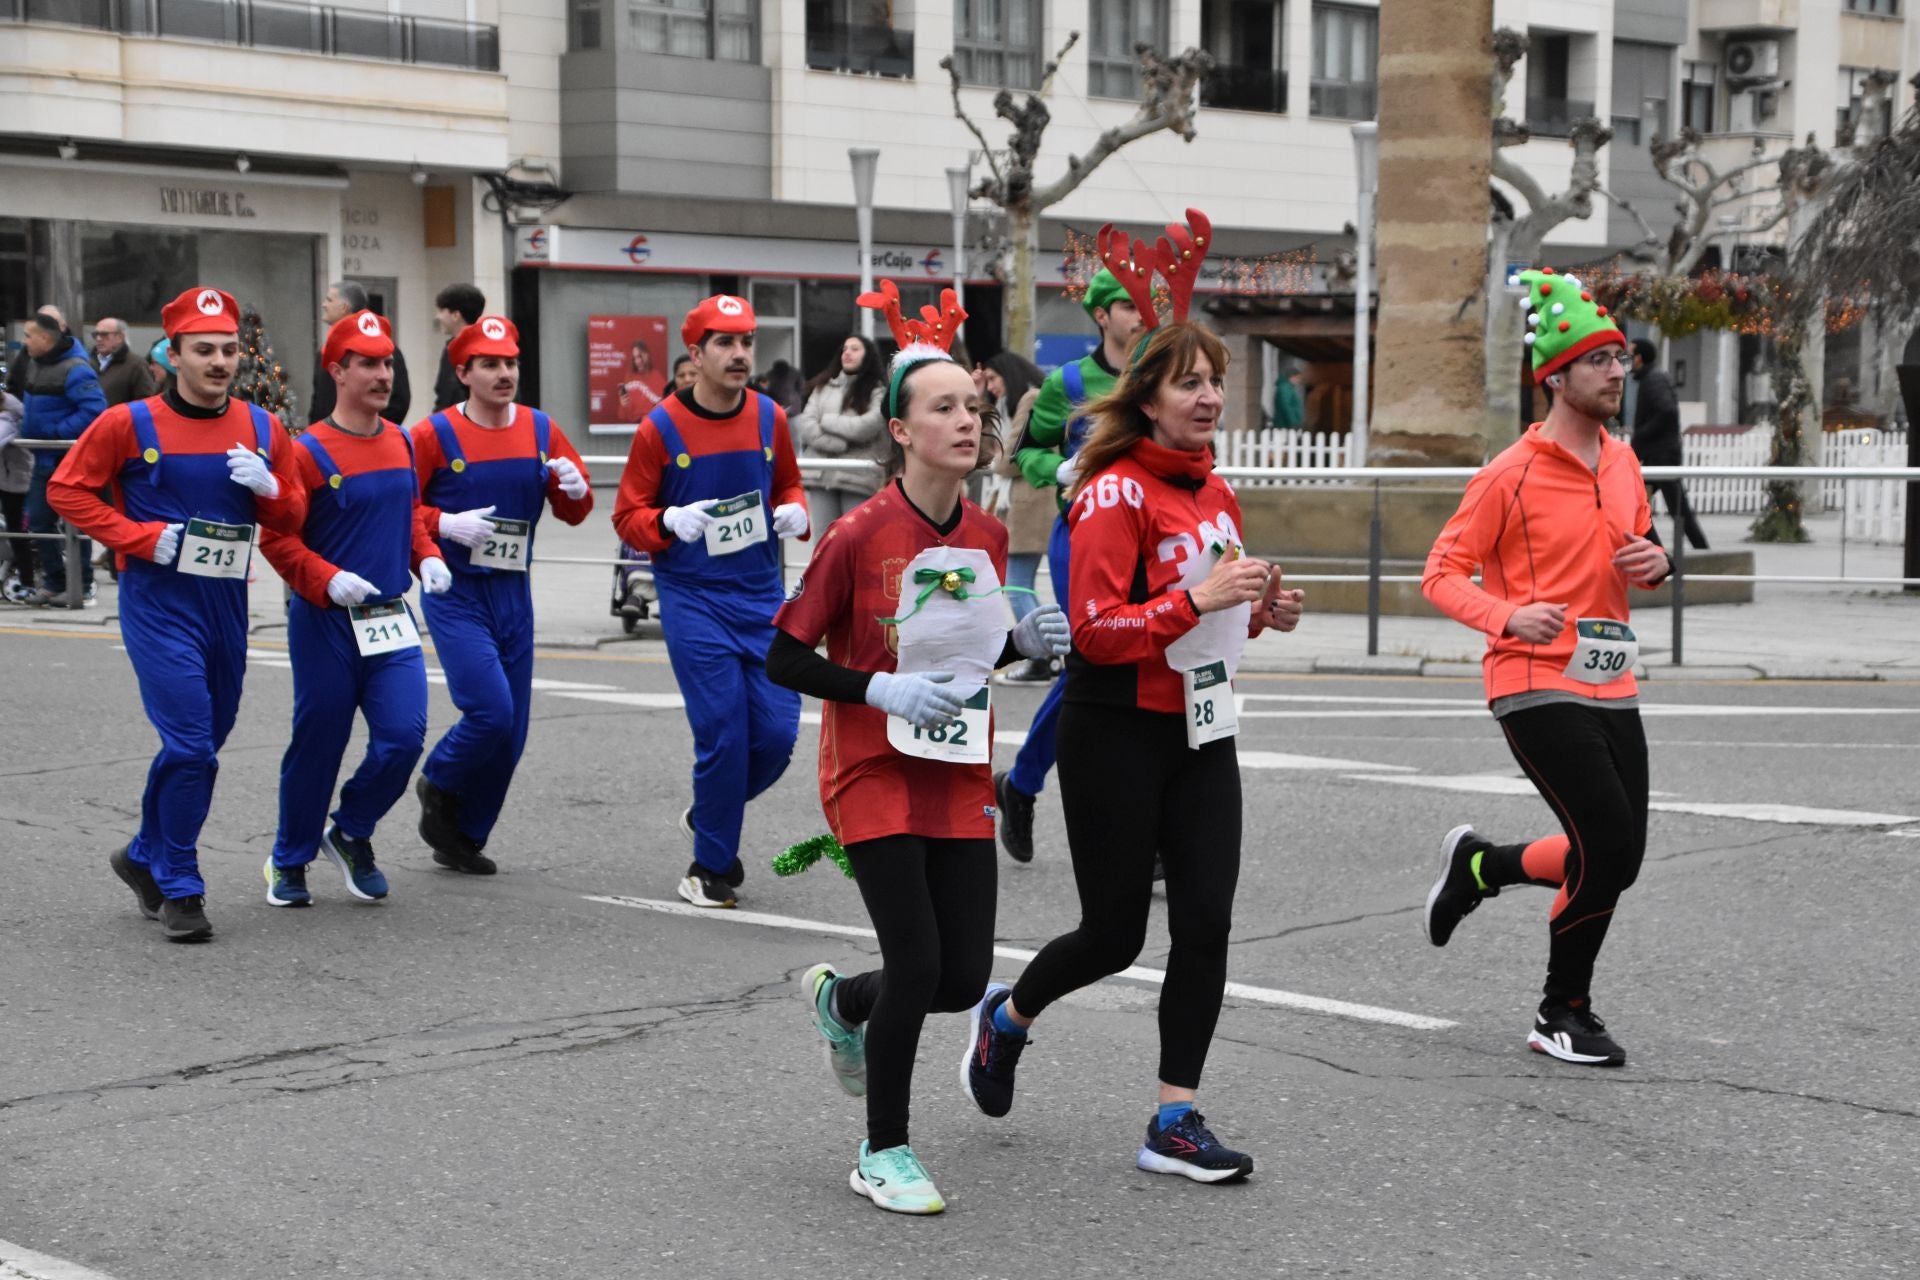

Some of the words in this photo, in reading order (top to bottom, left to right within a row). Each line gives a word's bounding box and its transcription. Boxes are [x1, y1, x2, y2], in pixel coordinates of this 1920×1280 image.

[200, 294, 219, 308] M
[362, 317, 377, 330] M
[1077, 474, 1144, 521] 360
[718, 517, 753, 542] 210
[194, 546, 235, 566] 213
[483, 540, 519, 559] 212
[366, 622, 403, 643] 211
[1584, 649, 1626, 671] 330
